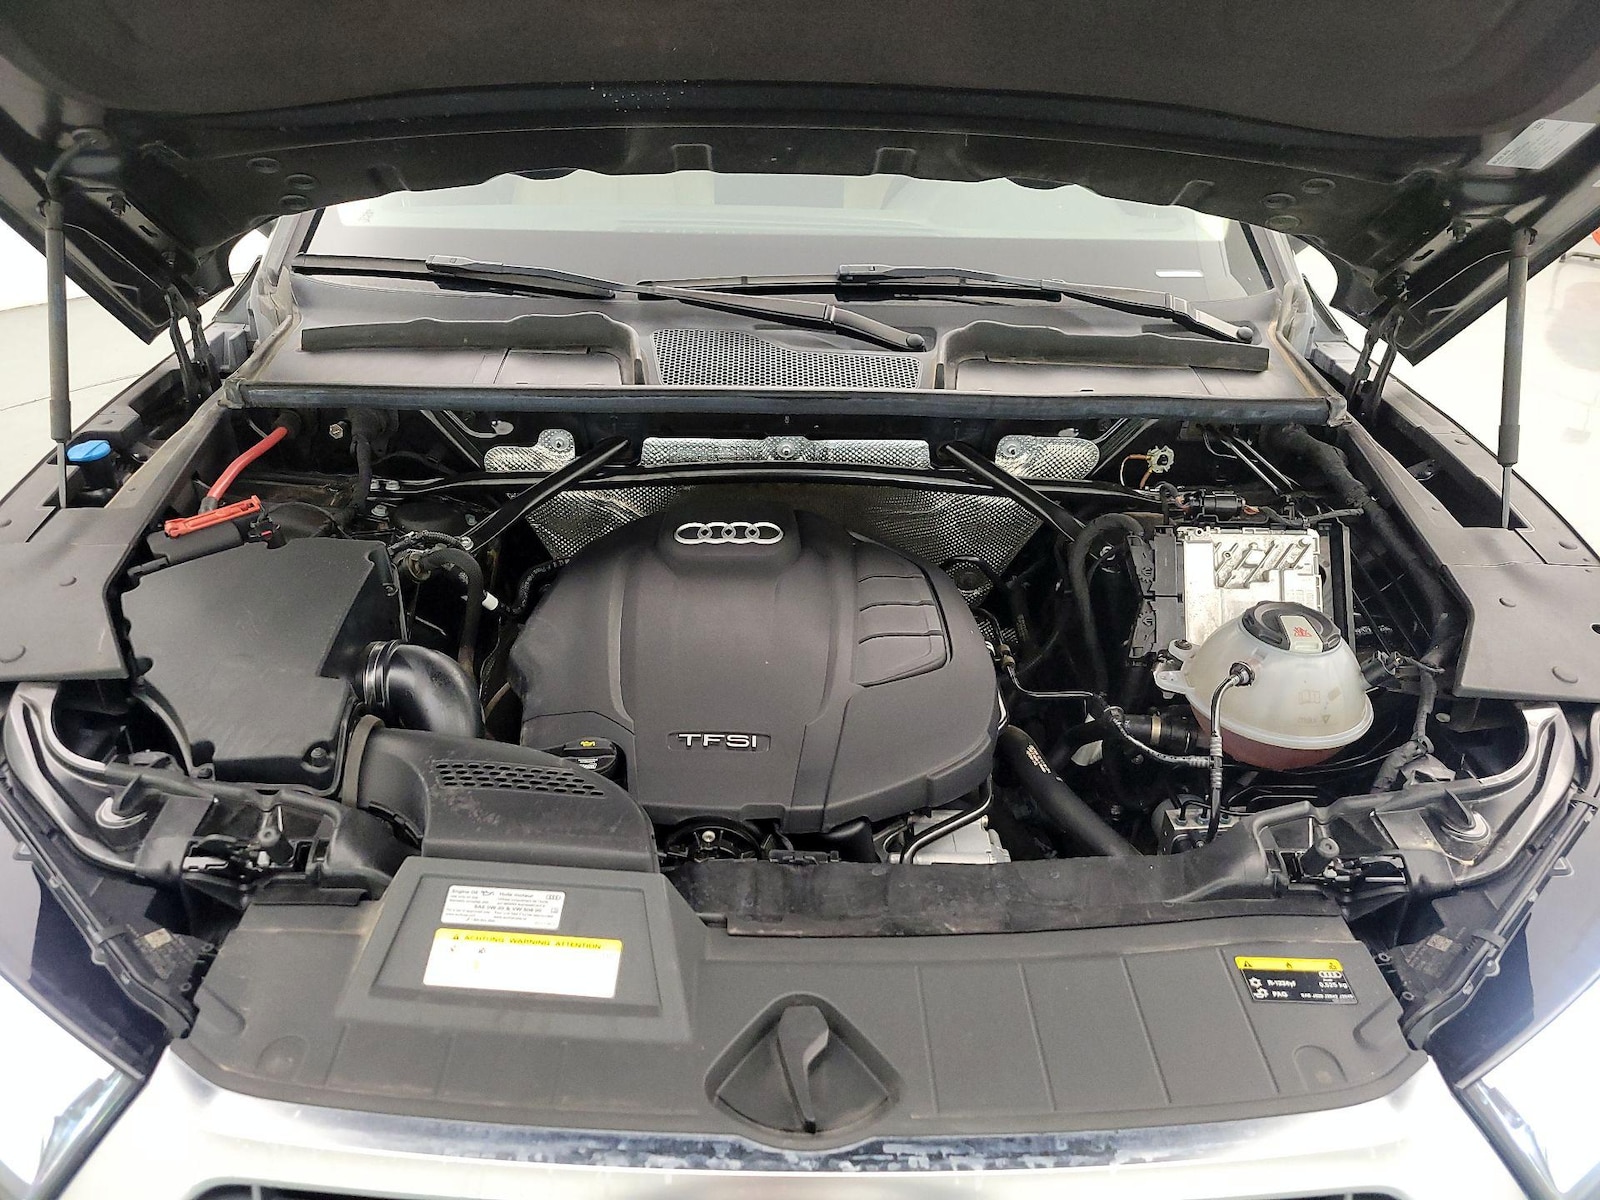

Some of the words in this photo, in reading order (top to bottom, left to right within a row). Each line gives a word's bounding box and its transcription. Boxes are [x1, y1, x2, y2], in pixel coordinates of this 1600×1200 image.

[678, 733, 757, 748] TFSI
[464, 934, 505, 943] ACHTUNG
[509, 937, 550, 946] WARNING
[555, 941, 602, 950] ATTENTION
[1272, 990, 1289, 998] PAG
